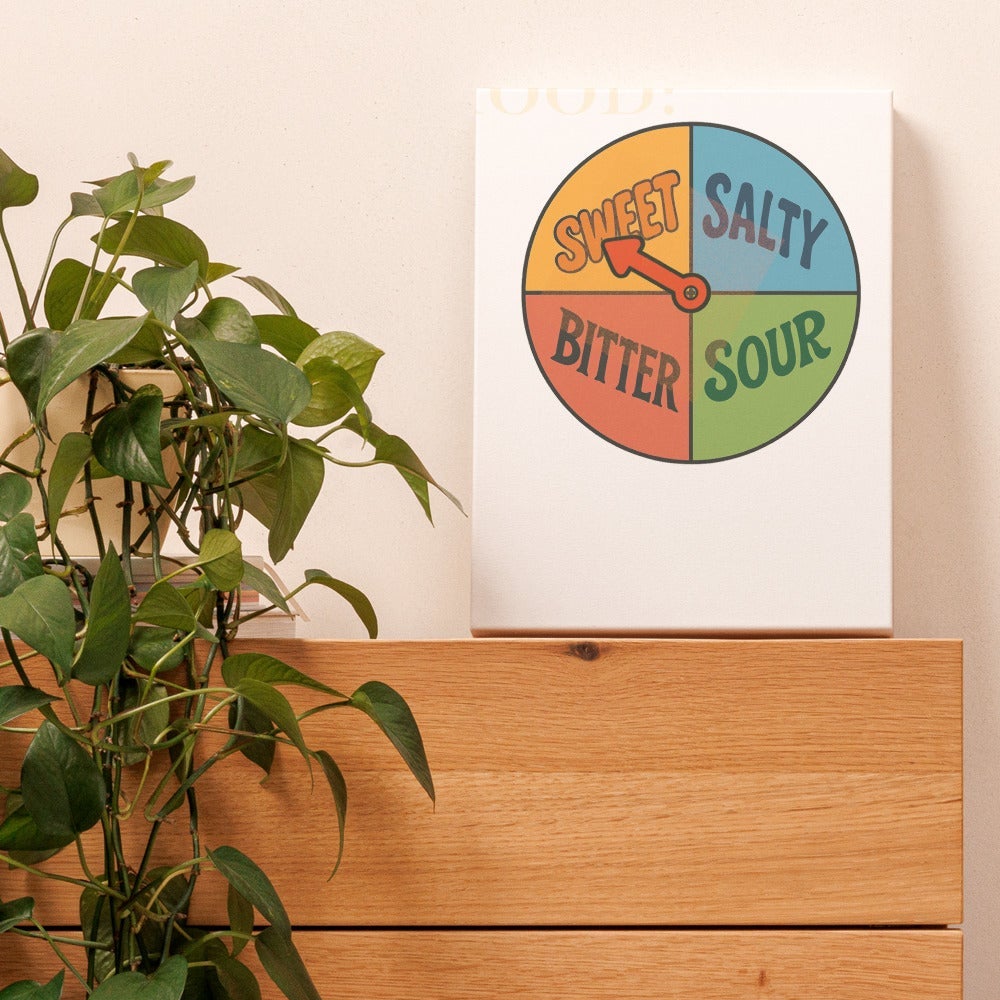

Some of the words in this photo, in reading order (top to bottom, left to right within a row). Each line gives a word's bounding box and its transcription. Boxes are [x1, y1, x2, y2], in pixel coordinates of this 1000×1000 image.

[554, 169, 681, 274] SWEET
[702, 172, 829, 270] SALTY
[550, 306, 681, 413] BITTER
[704, 310, 831, 402] SOUR
